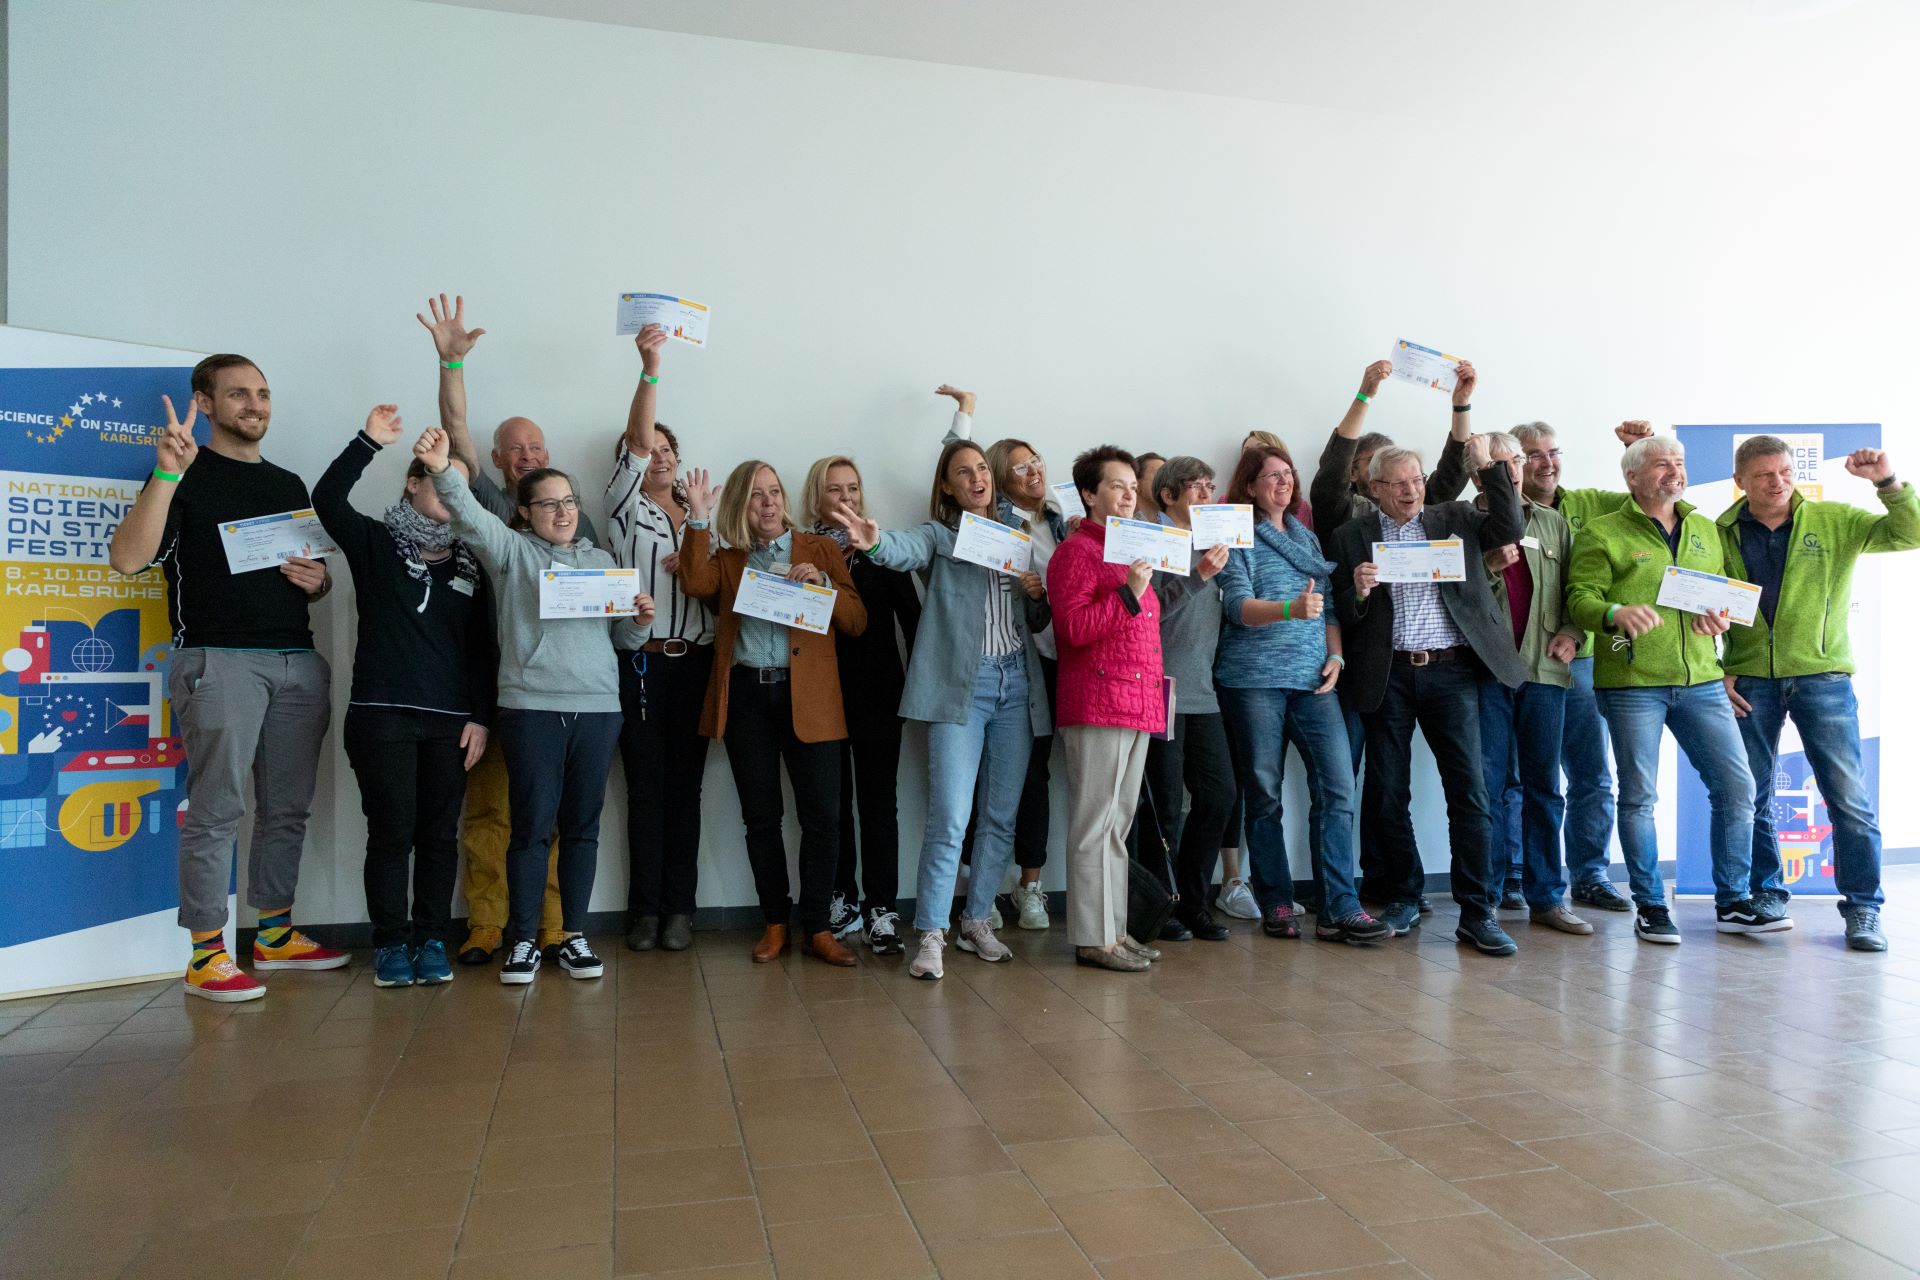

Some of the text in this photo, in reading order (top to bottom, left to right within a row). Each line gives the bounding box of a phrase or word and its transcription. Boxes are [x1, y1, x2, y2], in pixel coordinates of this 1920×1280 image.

[80, 418, 100, 430] ON
[103, 421, 146, 435] STAGE
[8, 480, 140, 501] NATIONAL
[8, 496, 134, 519] SCIEN
[7, 517, 118, 539] ON STA
[7, 538, 111, 558] FESTI
[6, 583, 162, 599] KARLSRUHE
